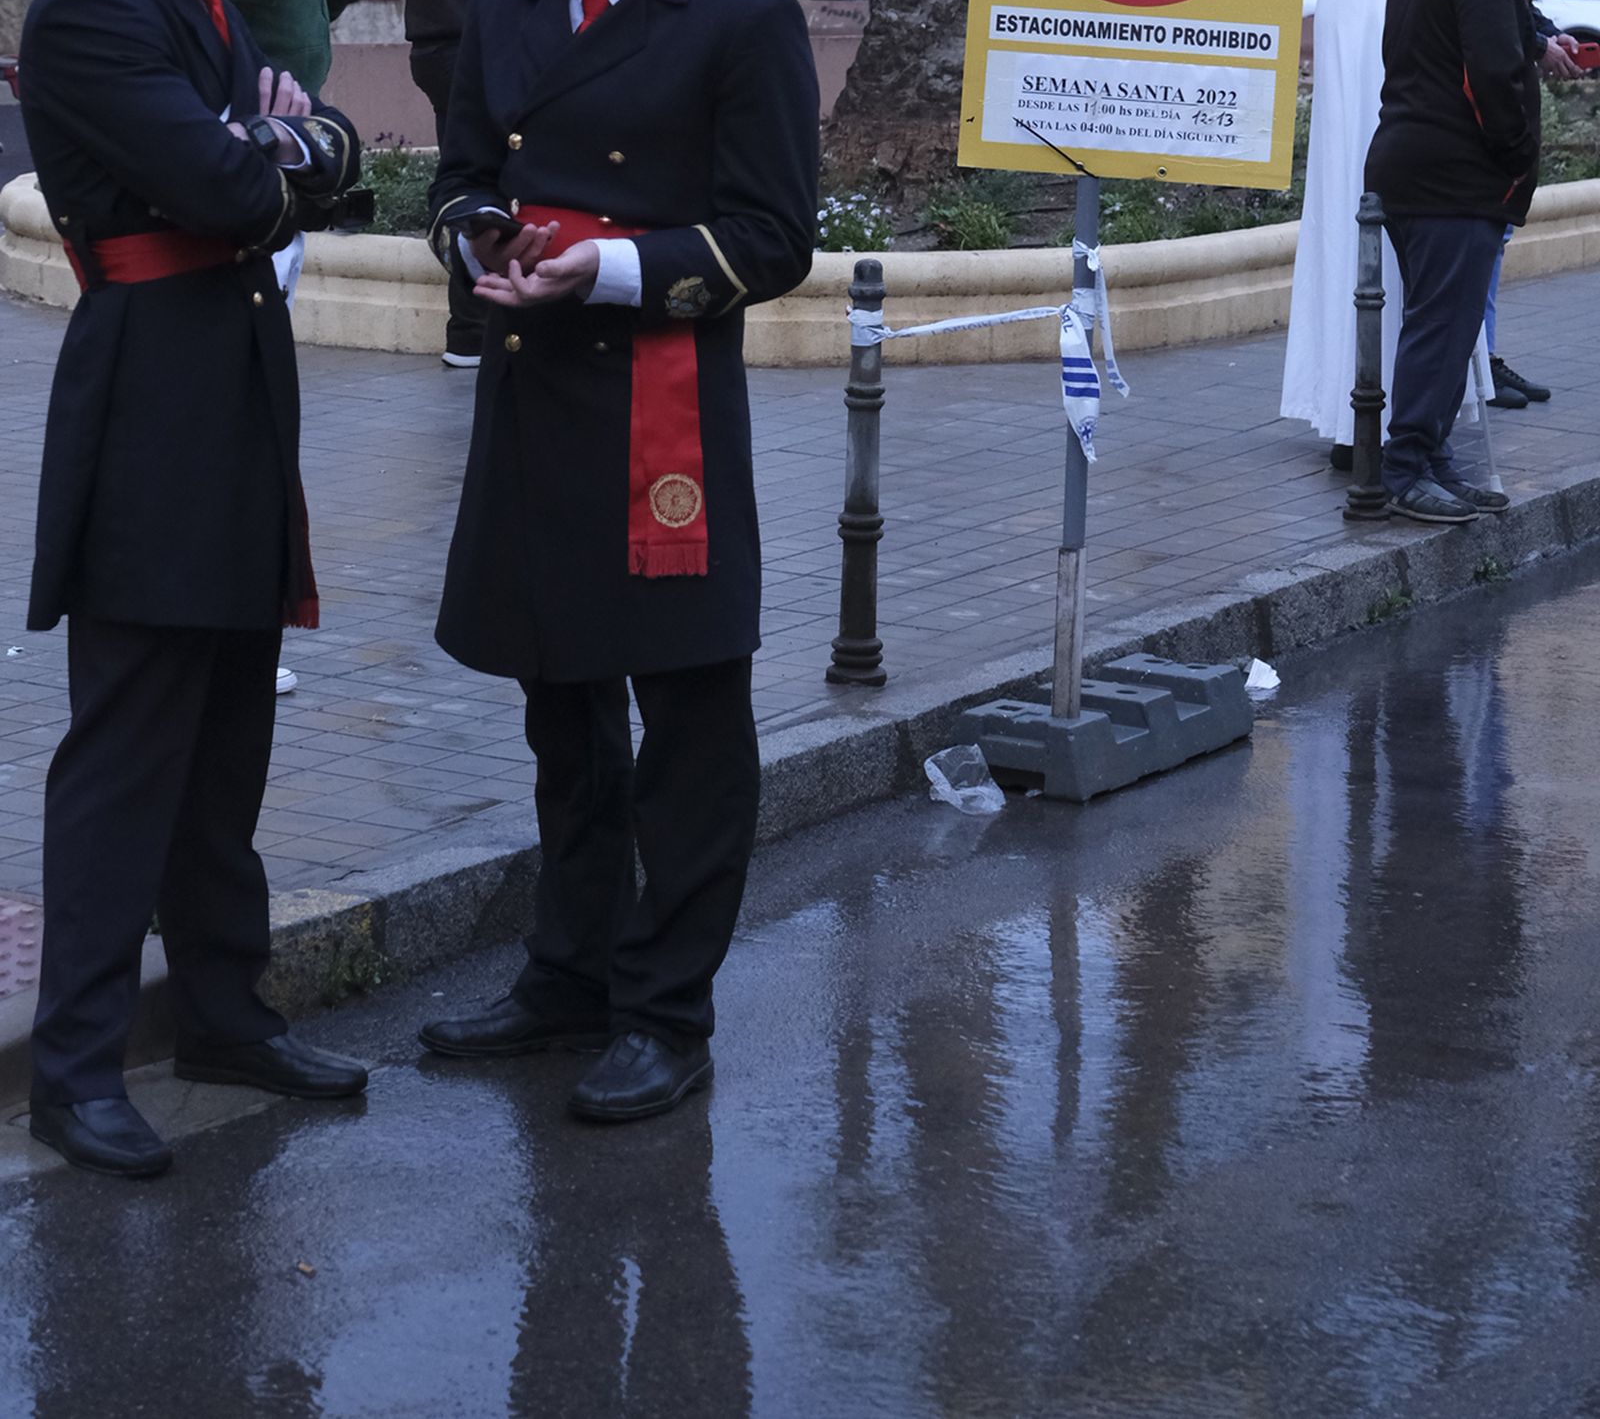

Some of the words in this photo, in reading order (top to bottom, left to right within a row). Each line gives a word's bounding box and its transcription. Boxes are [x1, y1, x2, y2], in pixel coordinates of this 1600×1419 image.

[996, 13, 1167, 43] ESTACIONAMIENTO
[1172, 26, 1272, 51] PROHIBIDO
[1022, 75, 1112, 97] SEMANA
[1116, 82, 1186, 102] SANTA
[1196, 88, 1237, 107] 2022
[1017, 98, 1055, 110] DESDE
[1058, 101, 1080, 113] LAS
[1119, 105, 1132, 117] hs
[1135, 107, 1159, 119] DEL
[1055, 122, 1078, 132] LAS
[1080, 121, 1113, 135] 04:00
[1115, 126, 1127, 136] hs
[1129, 127, 1152, 138] DEL
[1176, 130, 1239, 145] SIGUIENTE
